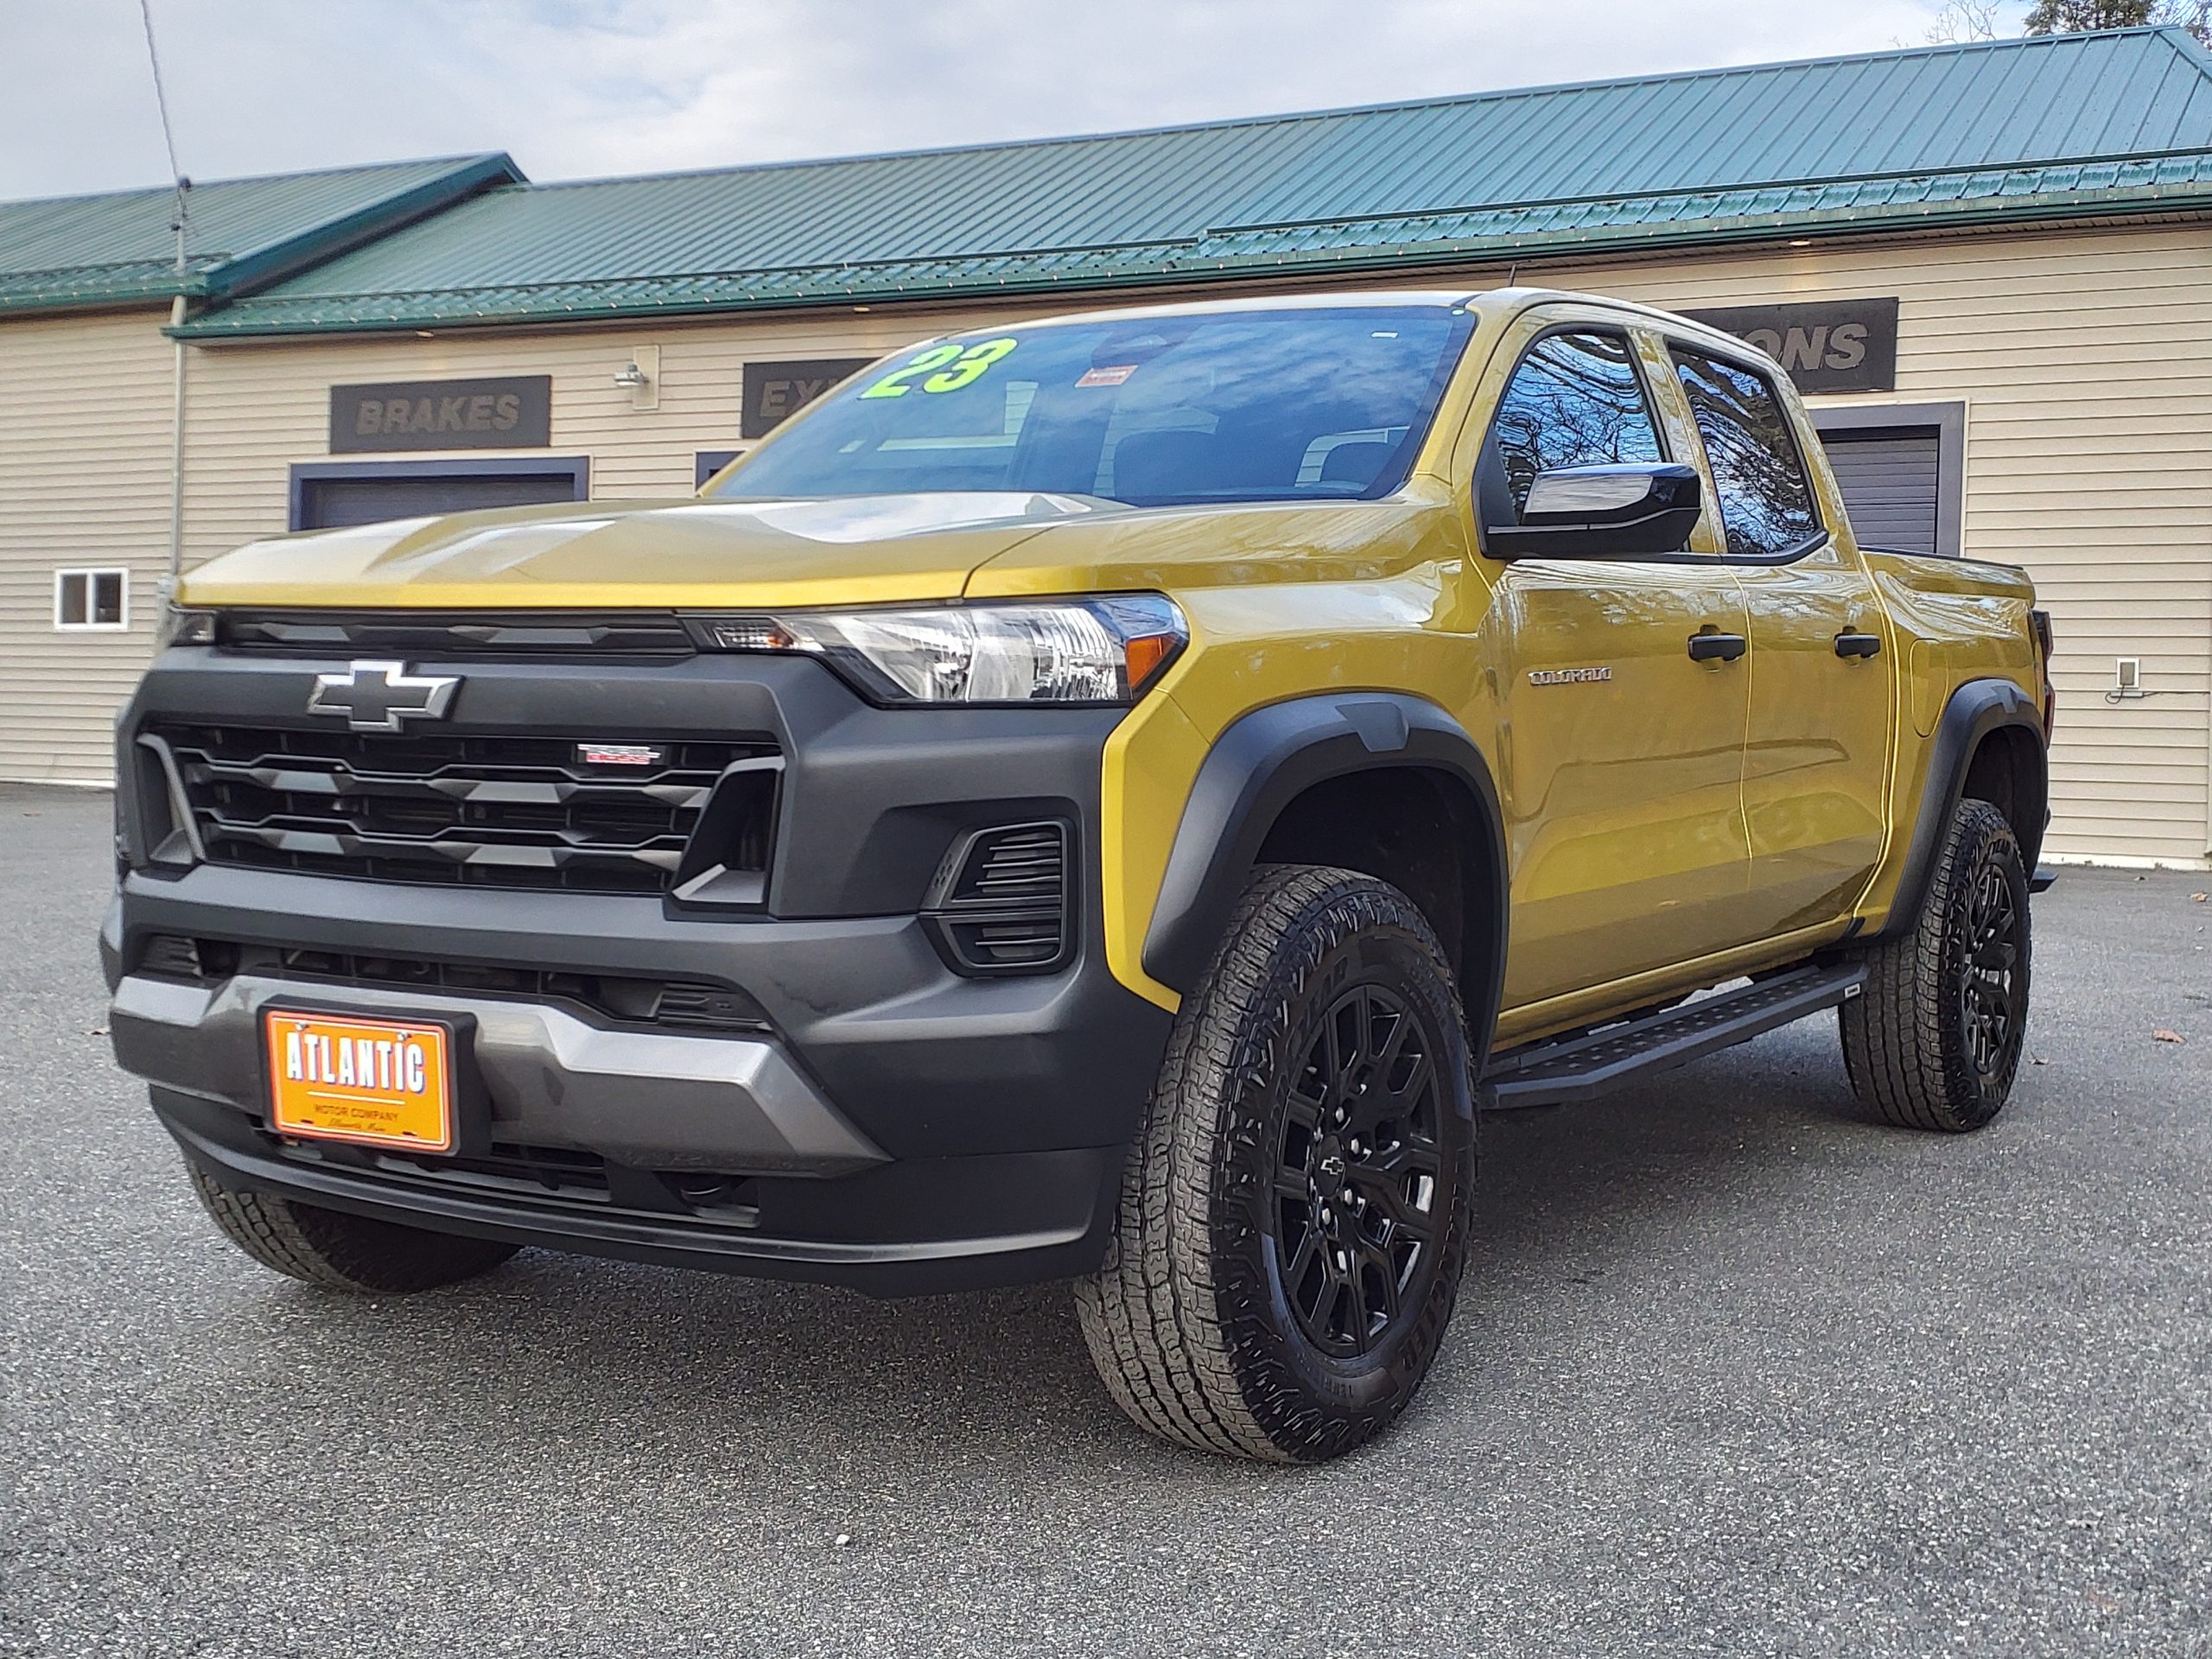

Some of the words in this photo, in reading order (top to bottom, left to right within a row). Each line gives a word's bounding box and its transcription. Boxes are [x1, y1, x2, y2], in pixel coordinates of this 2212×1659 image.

[860, 338, 1018, 399] 23
[1728, 324, 1871, 371] ONS
[356, 394, 520, 435] BRAKES
[1528, 667, 1612, 685] COLORADO
[286, 1032, 427, 1095] ATLANTIC
[315, 1104, 348, 1116] MOTOR
[352, 1108, 398, 1122] COMPANY
